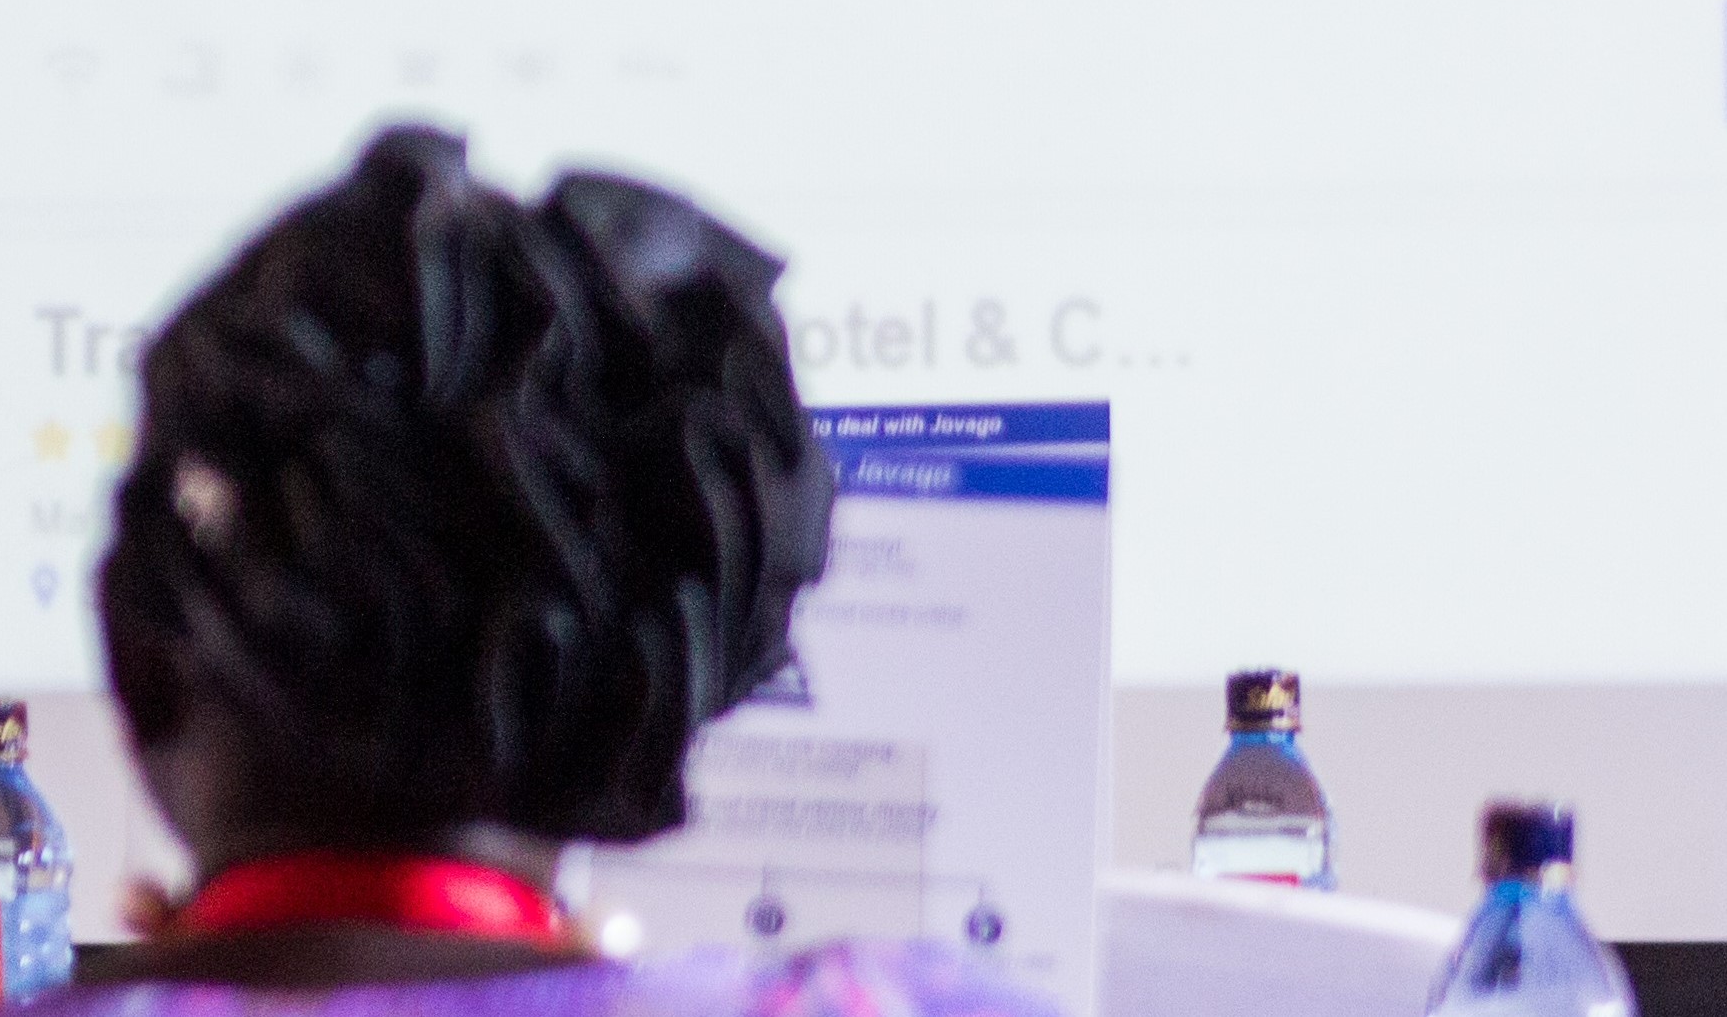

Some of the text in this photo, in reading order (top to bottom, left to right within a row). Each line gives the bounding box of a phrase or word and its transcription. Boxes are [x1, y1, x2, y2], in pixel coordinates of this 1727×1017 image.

[790, 298, 937, 369] otel
[964, 296, 1020, 368] &
[837, 414, 879, 436] deal
[884, 413, 924, 436] with
[930, 412, 1003, 440] Jovago
